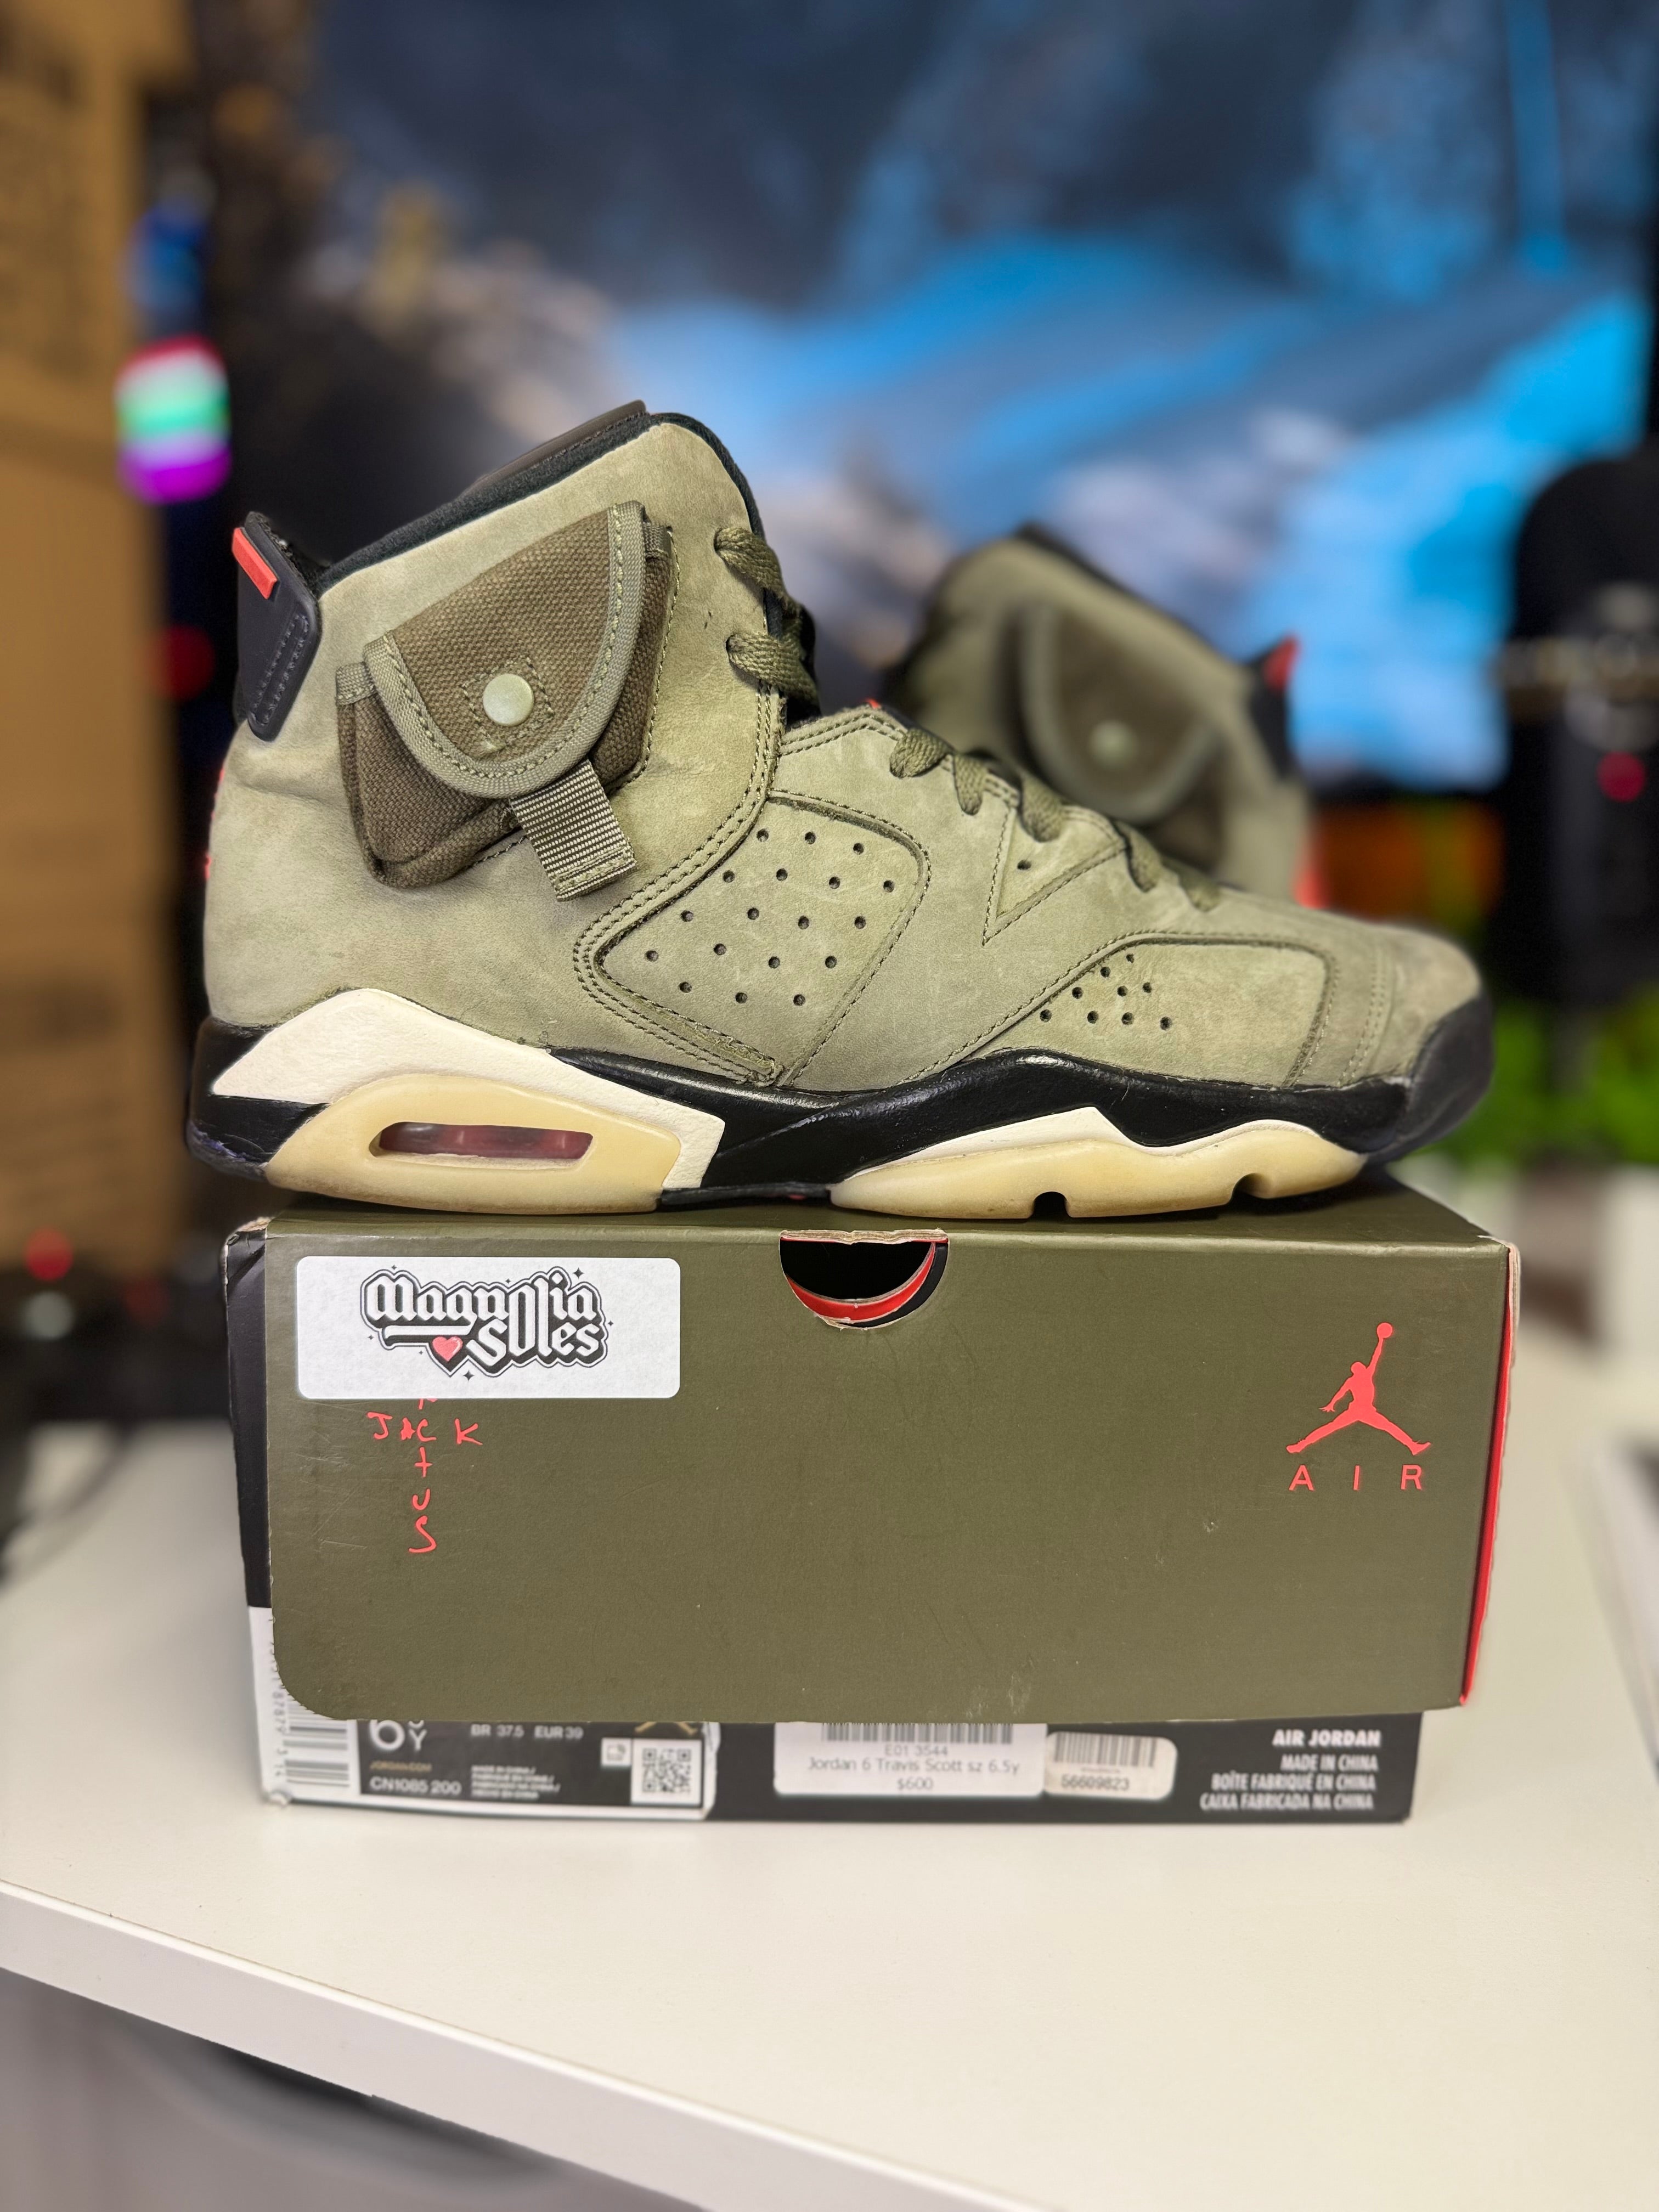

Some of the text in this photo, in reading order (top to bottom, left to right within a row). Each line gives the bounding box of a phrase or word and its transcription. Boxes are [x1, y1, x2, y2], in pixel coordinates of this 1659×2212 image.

[1288, 1464, 1423, 1491] AIR
[470, 1723, 492, 1737] BR
[534, 1724, 584, 1740] EUR 39
[1272, 1729, 1381, 1747] AIR JORDAN
[915, 1745, 949, 1756] 3544
[808, 1757, 1020, 1775] Jordan 6 Travis Scott sz 6.5y
[1280, 1754, 1379, 1773] MADE IN CHINA
[369, 1775, 462, 1796] CN1085 200
[897, 1776, 934, 1791] $600
[1315, 1774, 1334, 1791] EN
[1333, 1793, 1374, 1811] CHINA
